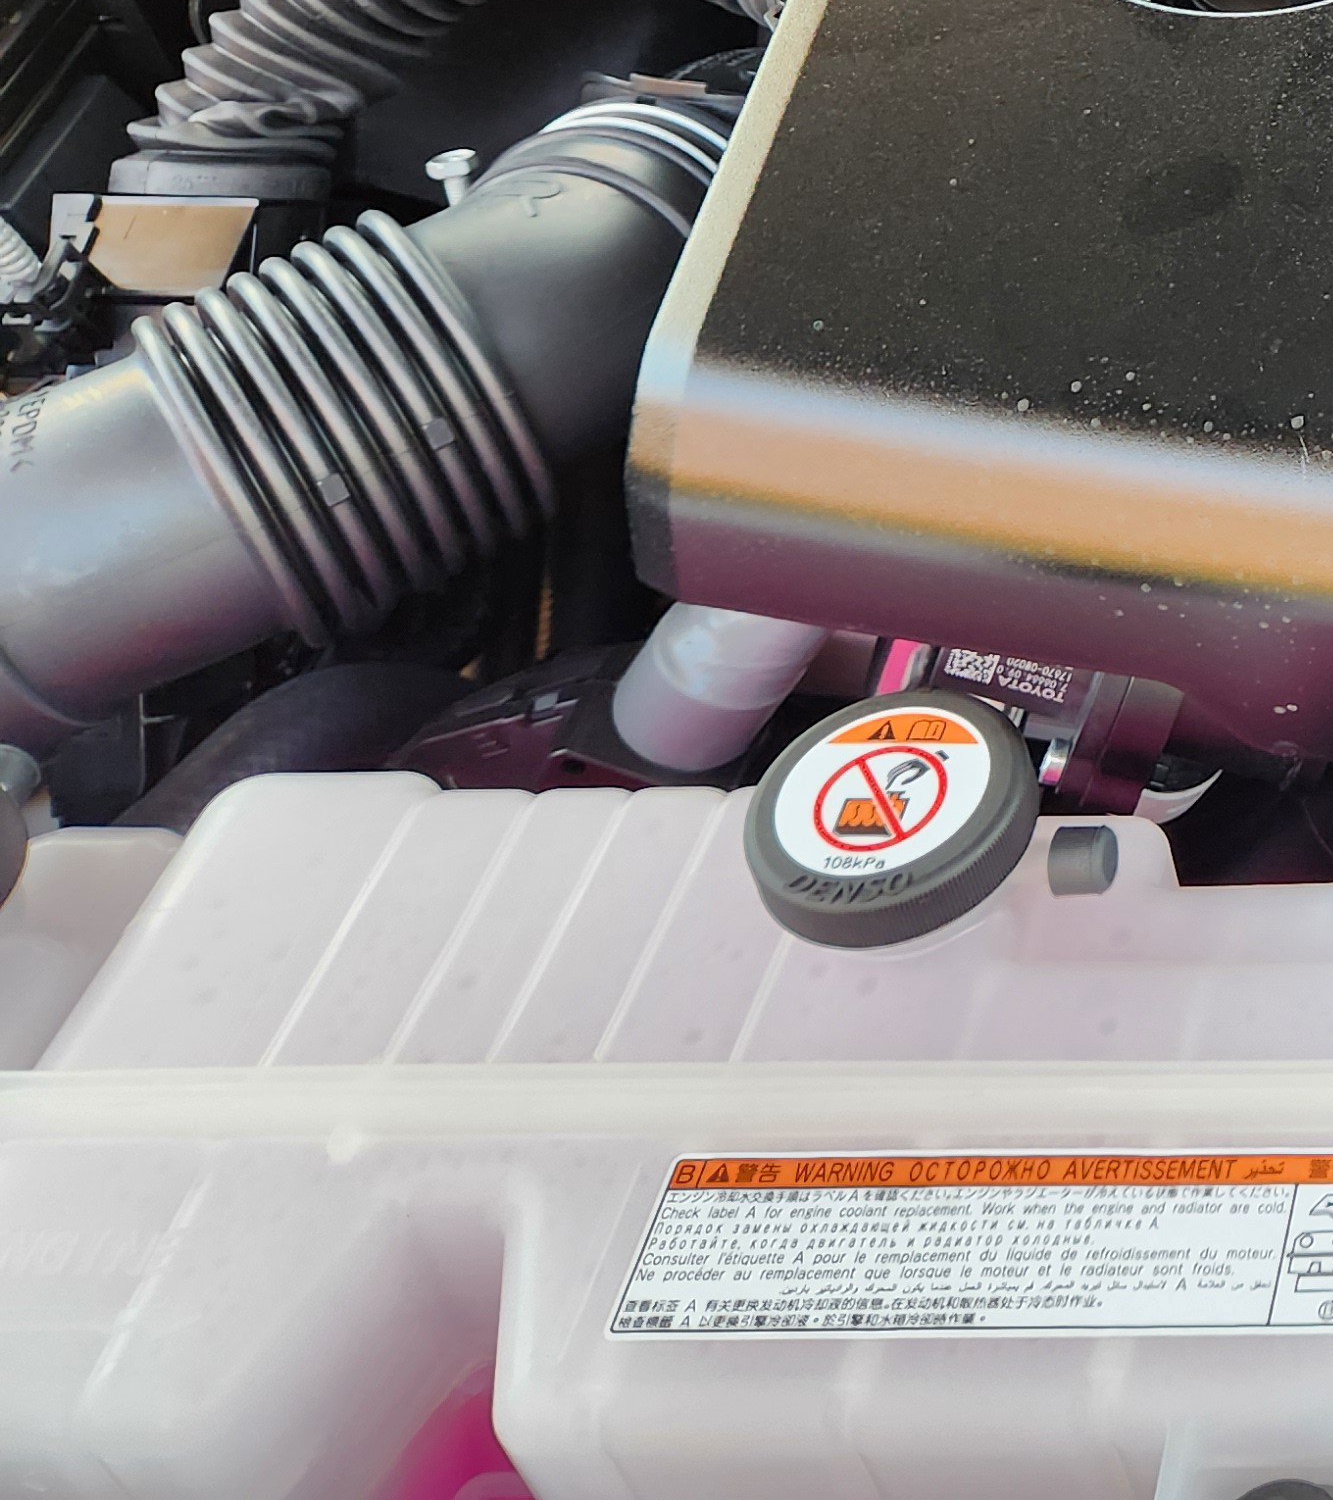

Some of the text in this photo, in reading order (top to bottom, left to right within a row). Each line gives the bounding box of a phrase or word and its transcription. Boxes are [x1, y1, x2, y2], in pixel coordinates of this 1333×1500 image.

[998, 675, 1065, 703] TOYOTA
[823, 855, 886, 870] 108kPa
[784, 873, 914, 904] DENSO
[676, 1164, 696, 1184] B
[735, 1162, 782, 1184] 警告
[795, 1161, 895, 1183] WARNING
[909, 1159, 1051, 1182] ОСТОРОЖНО
[1062, 1159, 1237, 1181] AVERTISSEMENT
[1244, 1160, 1286, 1180] تحذير
[661, 1201, 1286, 1221] Check label A for engine coolant replacement. Work when the engine and radiator are cold.
[654, 1222, 723, 1237] Порядок
[732, 1222, 792, 1234] замены
[800, 1219, 910, 1234] охлаждающей
[918, 1218, 1000, 1232] жидкости
[1036, 1218, 1055, 1230] на
[1066, 1216, 1142, 1230] табличке
[750, 1238, 798, 1250] когда
[806, 1237, 896, 1250] двигатель
[907, 1237, 916, 1248] и
[923, 1235, 1003, 1249] радиатор
[642, 1247, 1276, 1266] Consulter l'étiquette A pour le remplacement du liquide de refroidissement du moteur.
[635, 1262, 1235, 1283] Ne procéder au remplacement que lorsque le moteur et le radiateur sont froids.
[1176, 1277, 1187, 1291] A
[684, 1299, 696, 1312] A
[679, 1315, 690, 1328] A
